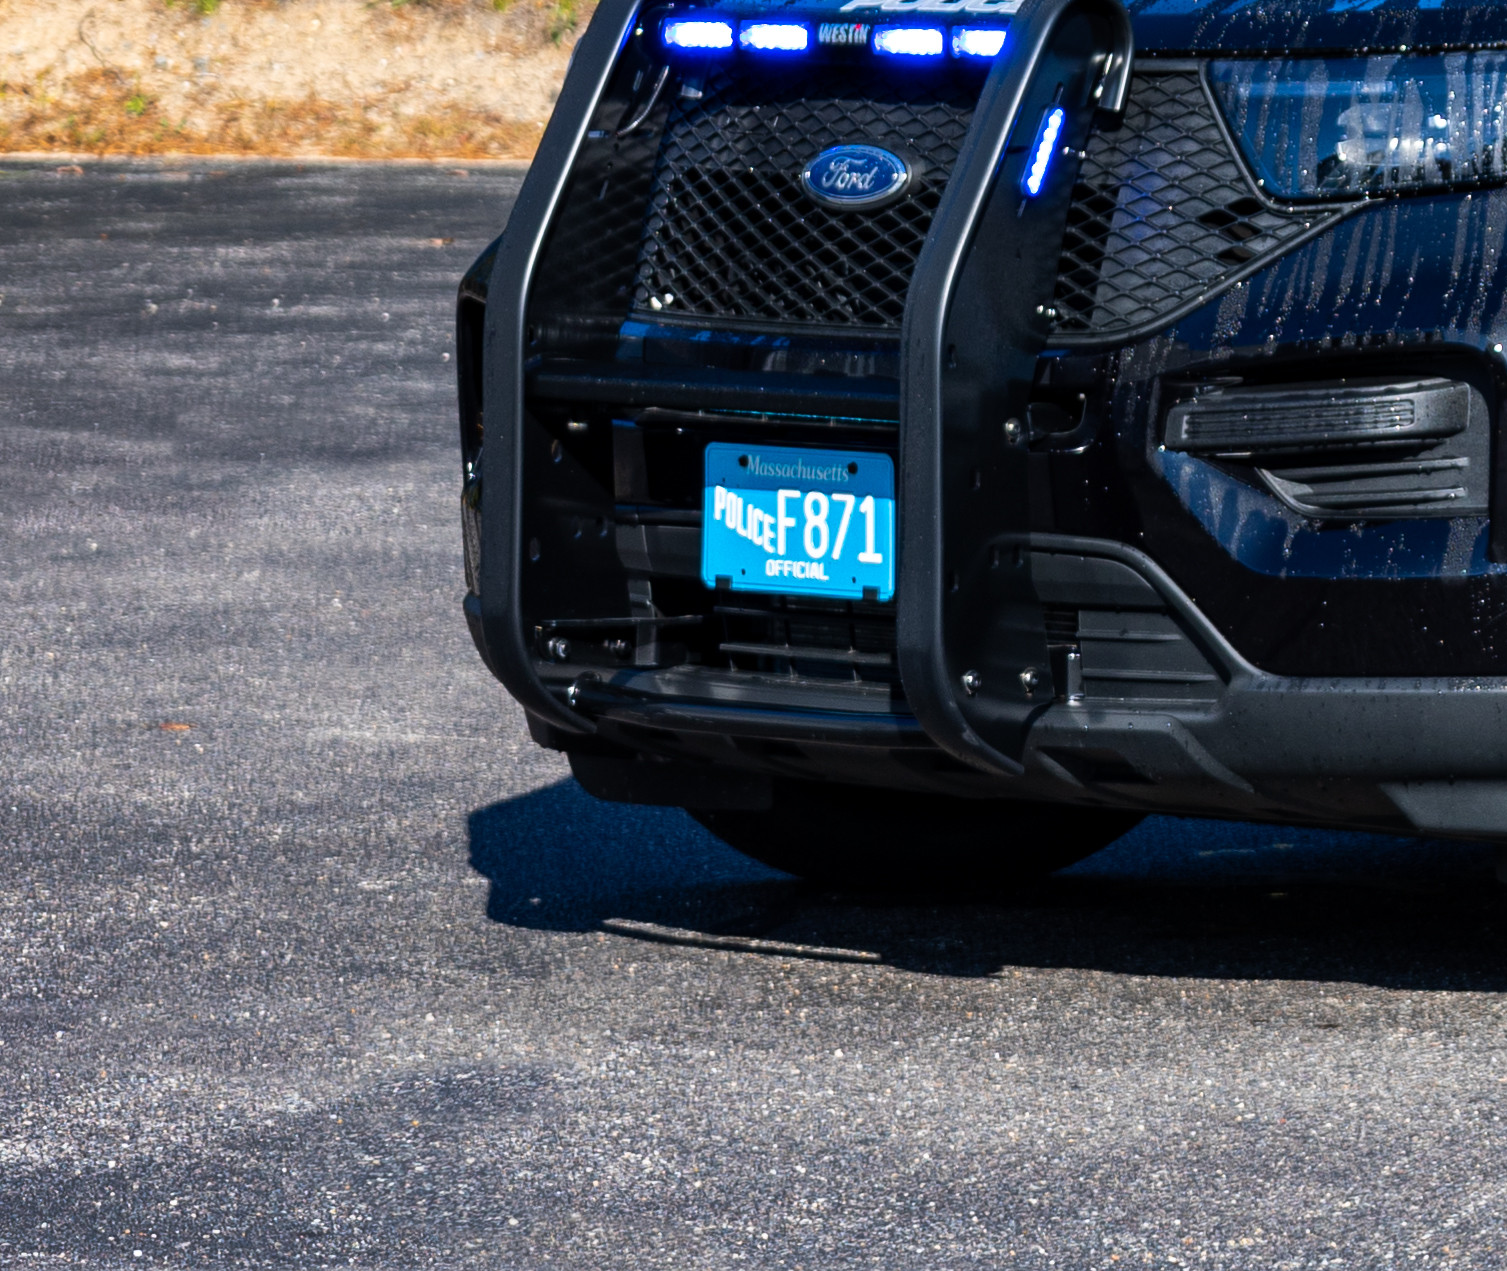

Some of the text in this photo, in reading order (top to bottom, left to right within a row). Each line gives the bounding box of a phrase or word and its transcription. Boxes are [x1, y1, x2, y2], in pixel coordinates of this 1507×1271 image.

[820, 157, 877, 191] Ford
[746, 454, 849, 482] Massachusetts
[713, 485, 883, 564] POLICE F871
[765, 559, 829, 581] OFFICIAL
